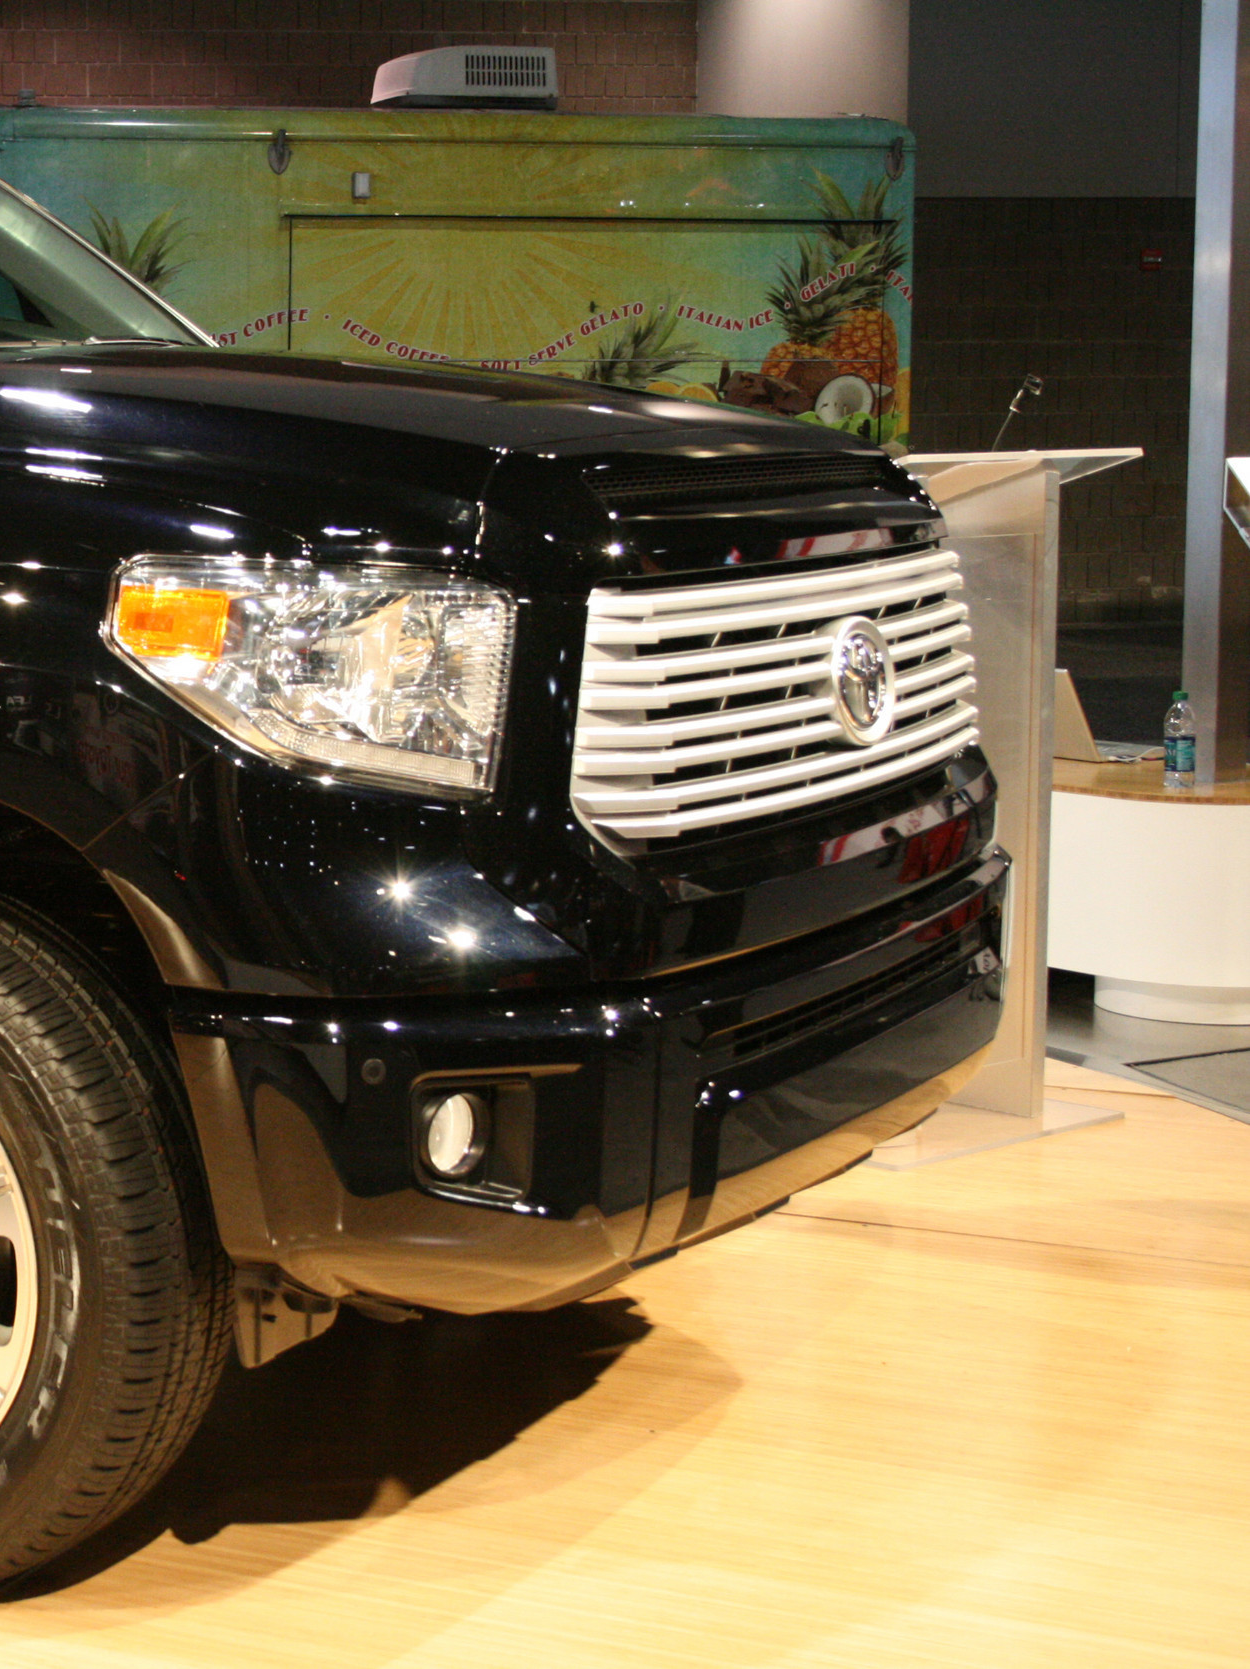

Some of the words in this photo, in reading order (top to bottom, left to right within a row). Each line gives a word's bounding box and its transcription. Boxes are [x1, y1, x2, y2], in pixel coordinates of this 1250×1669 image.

[243, 309, 308, 337] COFFEE
[342, 319, 381, 347] ICED
[528, 332, 575, 366] SERVE
[579, 302, 644, 337] GELATO
[676, 304, 744, 332] ITALIAN
[749, 309, 774, 330] ICE
[801, 262, 856, 301] GELATI
